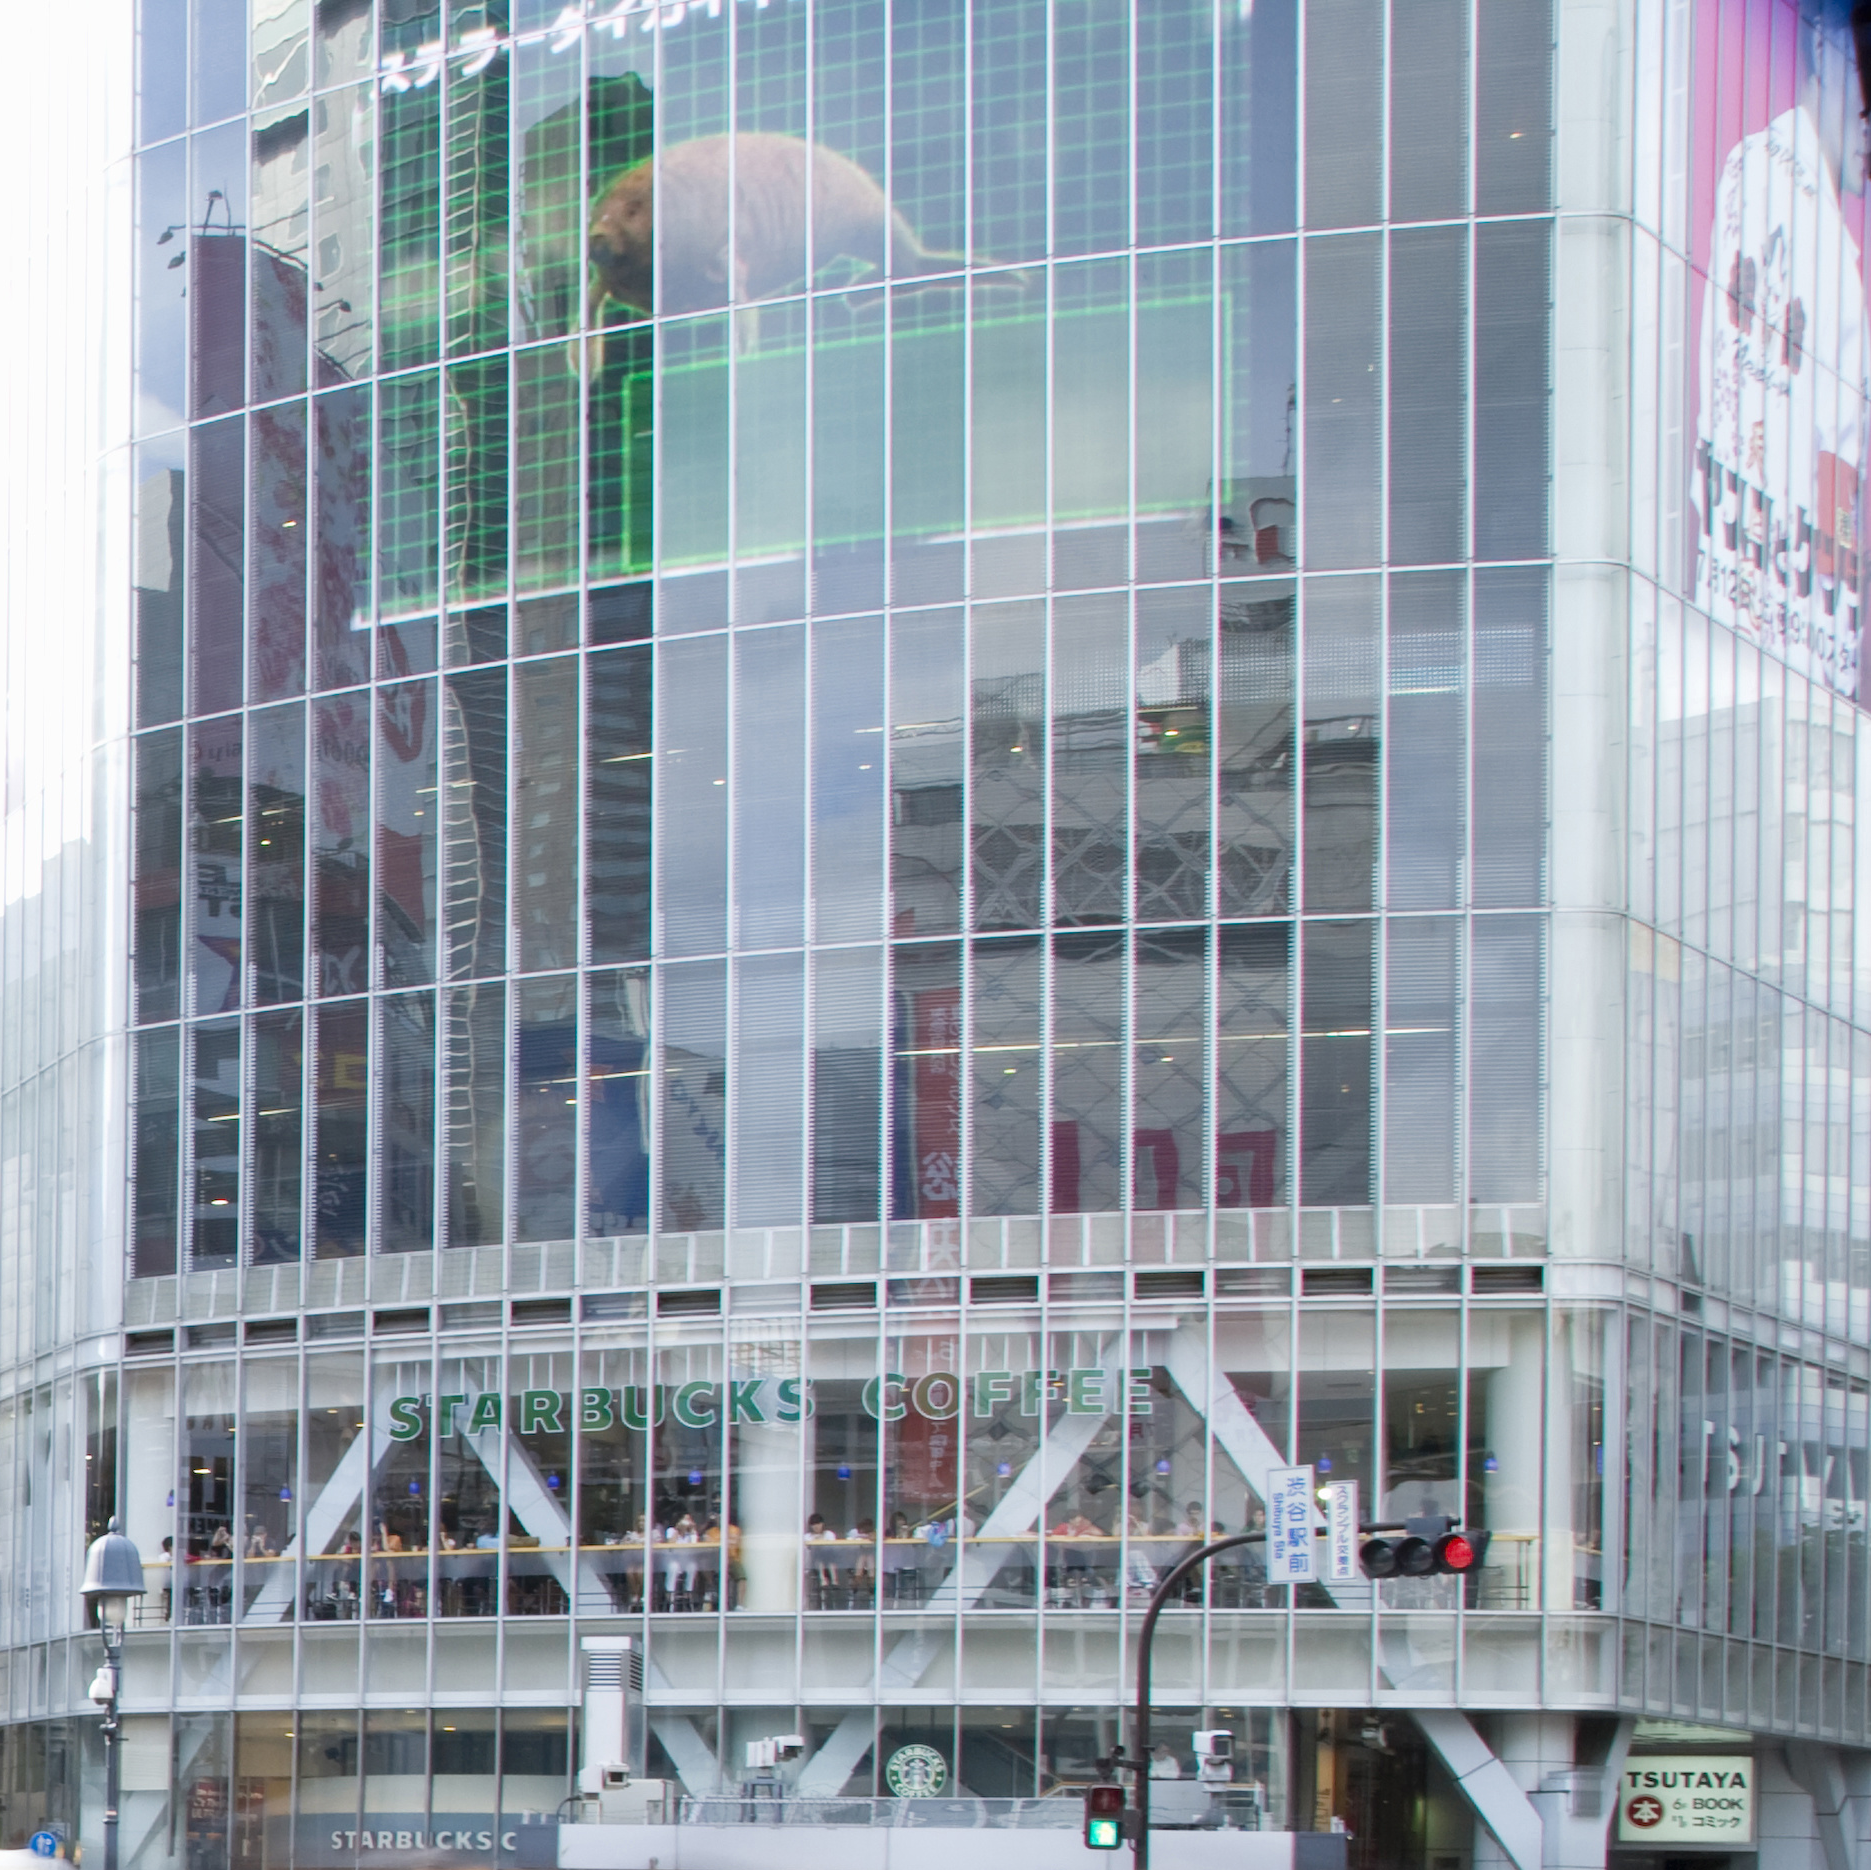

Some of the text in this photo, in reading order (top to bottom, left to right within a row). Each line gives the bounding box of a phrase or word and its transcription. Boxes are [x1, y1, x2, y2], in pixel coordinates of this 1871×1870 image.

[388, 1366, 1154, 1442] STARBUCKS COFFEE
[1272, 1492, 1284, 1537] Shibuya
[1286, 1476, 1309, 1573] 渋谷駅前
[1626, 1771, 1746, 1789] TSUTAYA
[1632, 1800, 1660, 1823] 本
[1692, 1798, 1744, 1810] BOOK
[1692, 1816, 1741, 1828] コミック
[330, 1829, 518, 1852] STARBUCKS C
